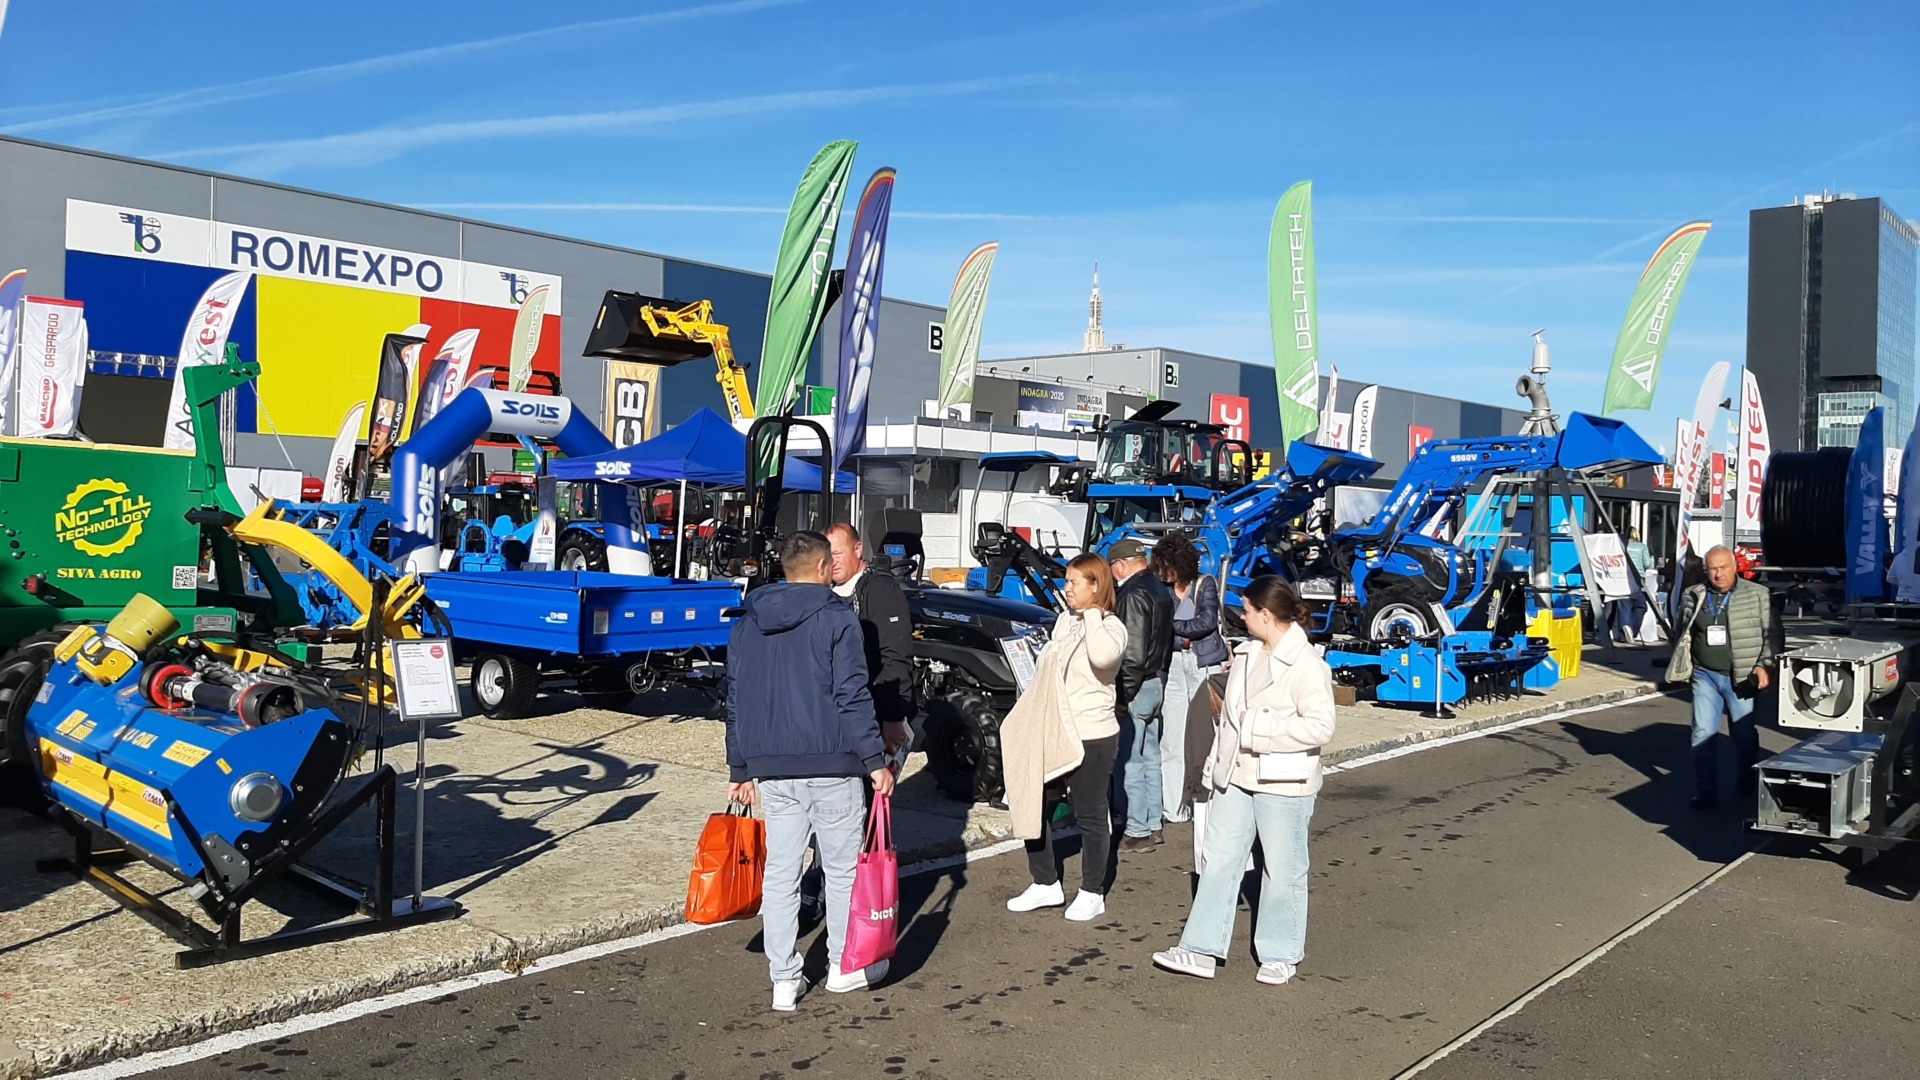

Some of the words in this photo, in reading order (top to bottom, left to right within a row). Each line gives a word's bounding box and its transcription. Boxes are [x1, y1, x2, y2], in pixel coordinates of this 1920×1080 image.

[231, 230, 443, 292] ROMEXPO
[1288, 213, 1312, 350] DELTATEH
[44, 313, 59, 368] GASPARDO
[40, 378, 51, 422] MASCHIO
[1020, 387, 1049, 399] INDAGRA
[1050, 390, 1065, 401] 2025
[56, 508, 152, 543] TECHNOLOGY
[1855, 494, 1879, 575] VALLEY
[56, 568, 96, 579] SIVA
[99, 569, 142, 580] AGRO
